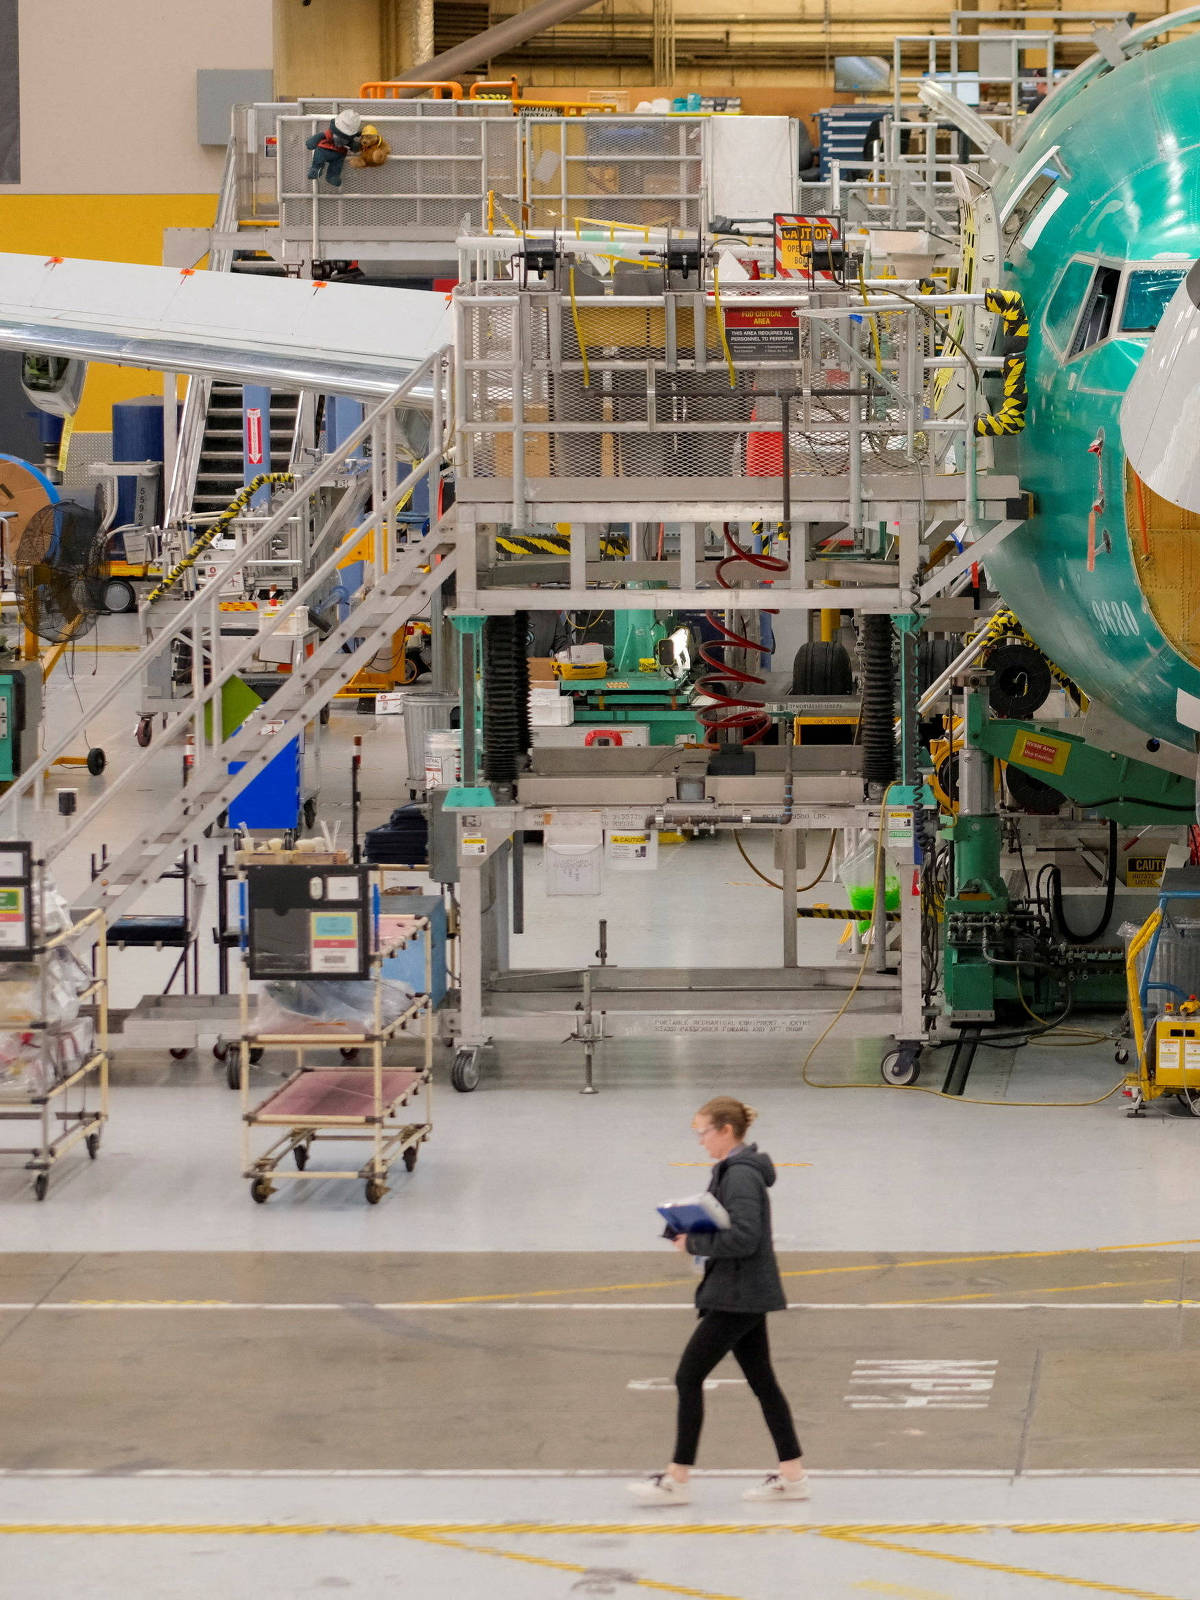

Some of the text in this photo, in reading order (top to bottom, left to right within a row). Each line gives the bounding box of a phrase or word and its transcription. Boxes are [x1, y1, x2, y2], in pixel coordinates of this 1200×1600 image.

[783, 226, 829, 240] CAUTON
[1091, 599, 1140, 637] 9680
[843, 1359, 999, 1409] MPH
